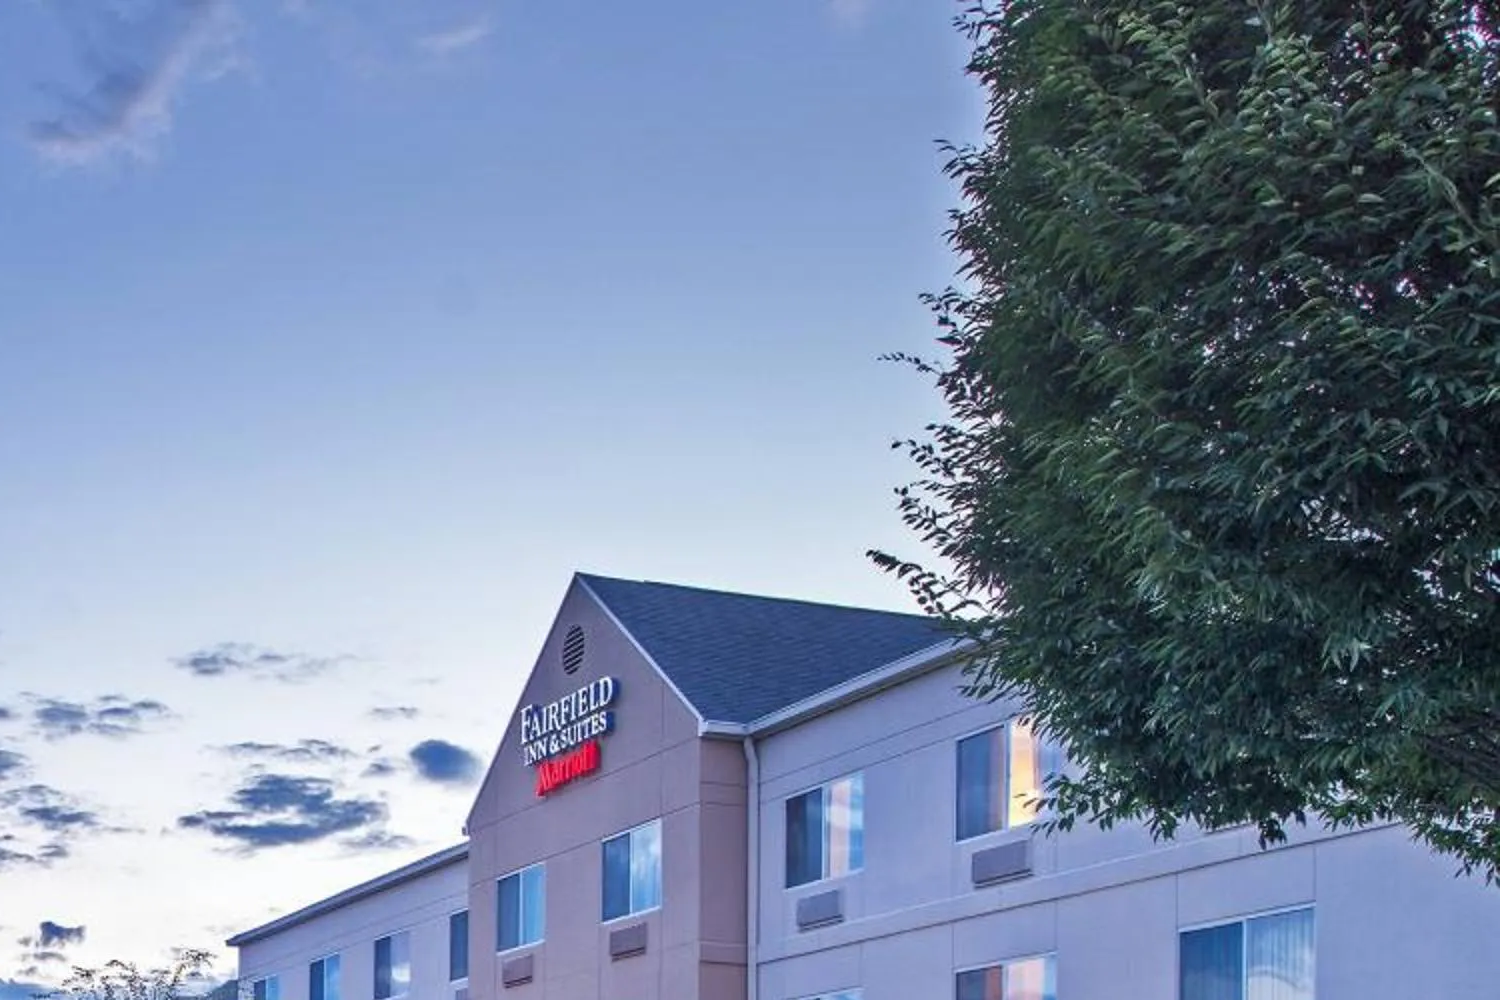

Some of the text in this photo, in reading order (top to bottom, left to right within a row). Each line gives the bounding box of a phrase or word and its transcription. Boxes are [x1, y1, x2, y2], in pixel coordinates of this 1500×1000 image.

[521, 676, 613, 745] FAIRFIELD
[524, 738, 548, 767] INN
[560, 711, 607, 750] SUITES
[535, 740, 599, 798] Marriott
